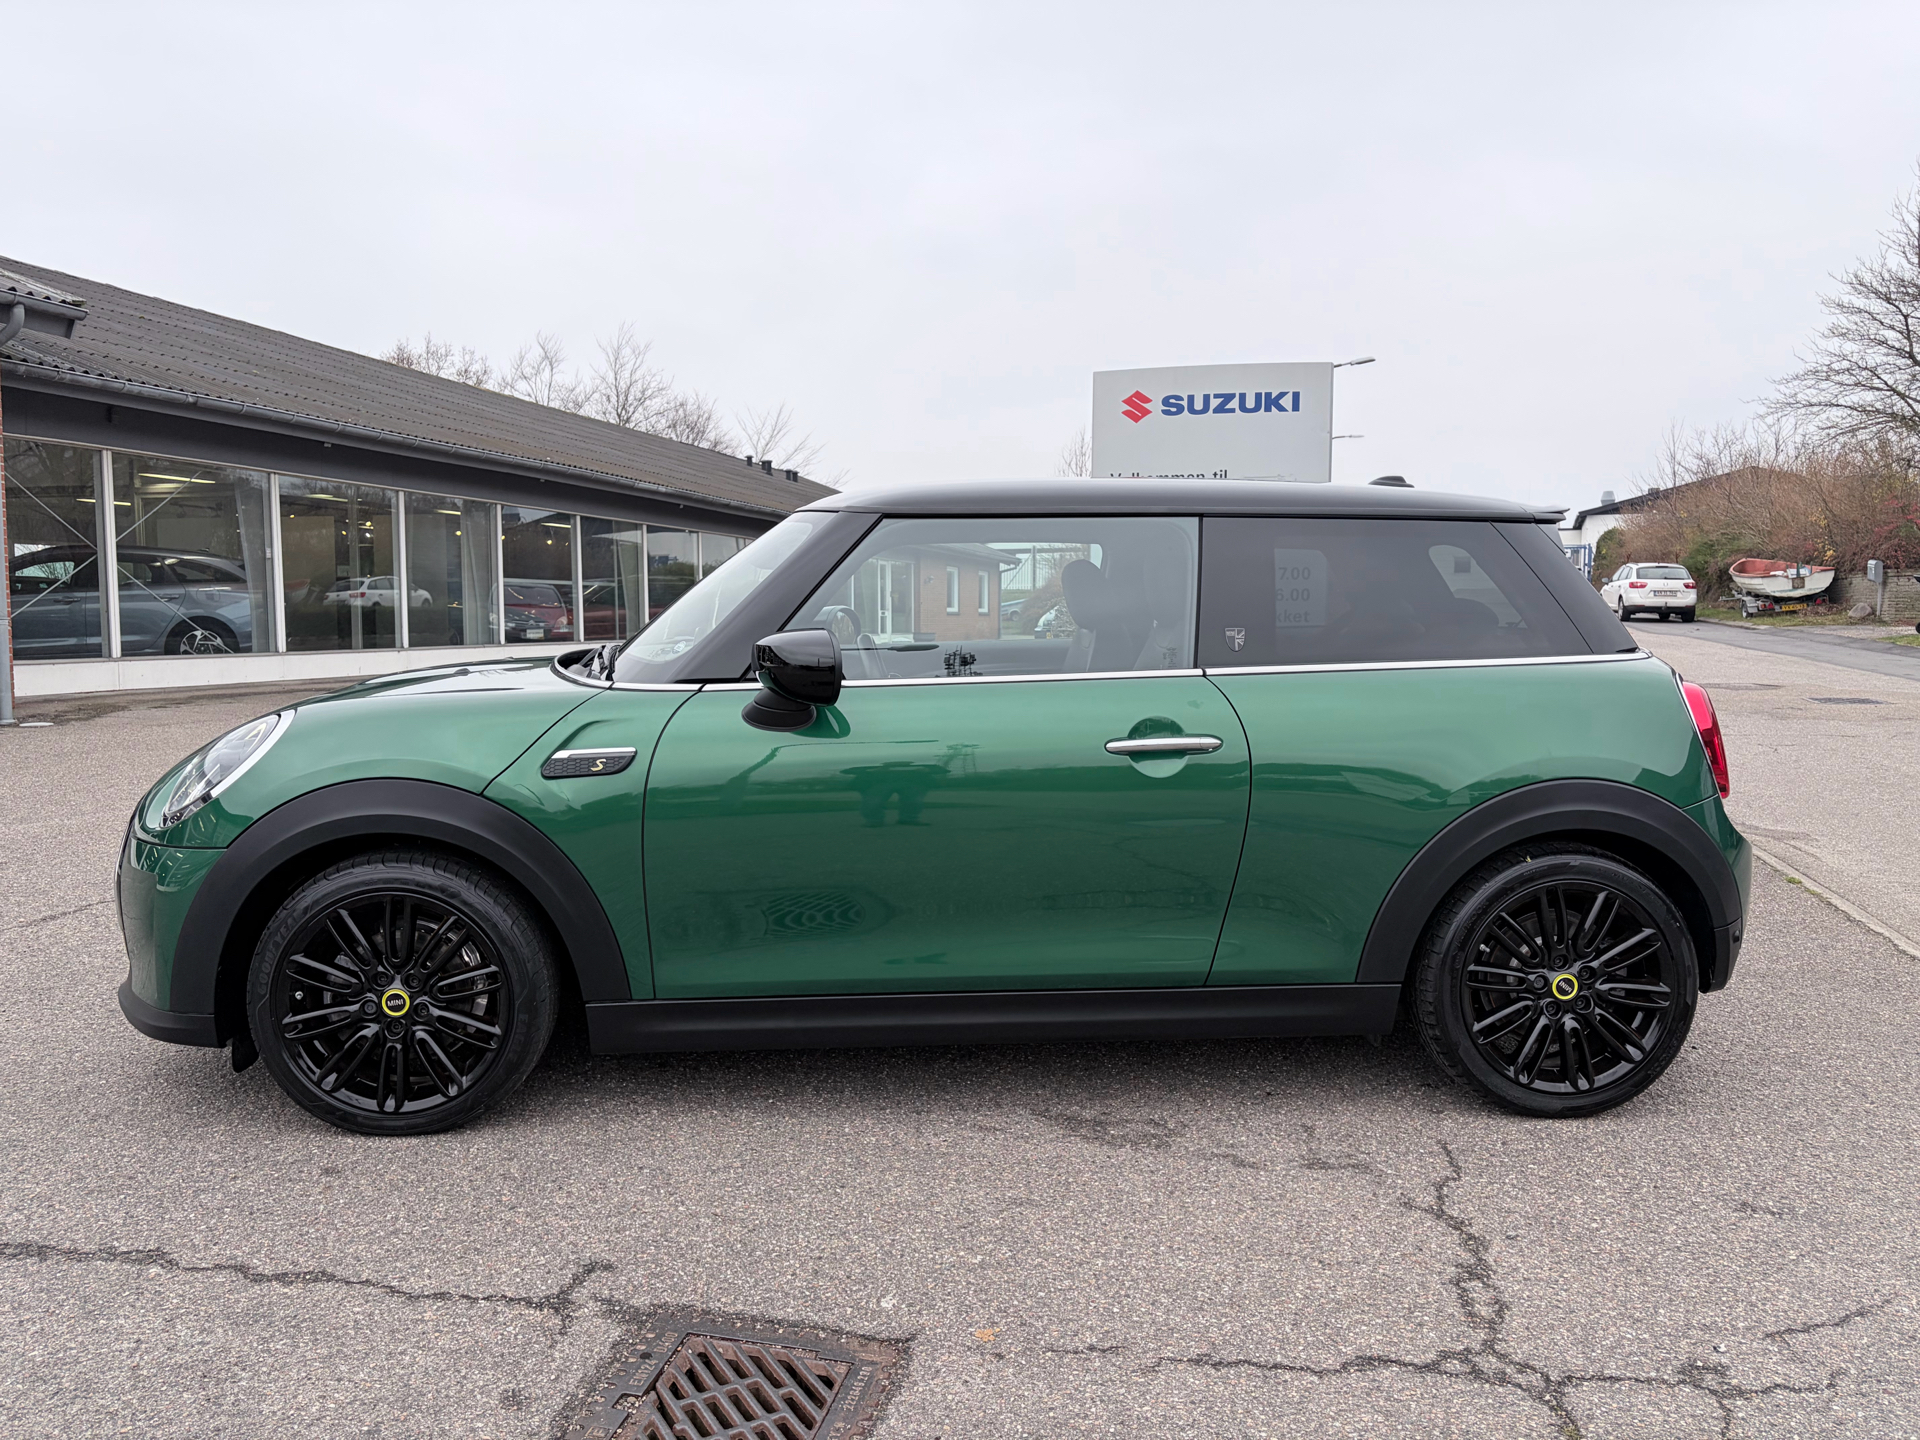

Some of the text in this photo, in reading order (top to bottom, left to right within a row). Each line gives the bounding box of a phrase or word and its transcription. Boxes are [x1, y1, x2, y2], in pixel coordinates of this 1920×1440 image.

[1161, 391, 1300, 416] SUZUKI
[1213, 469, 1228, 479] til
[1278, 567, 1311, 580] 7.00
[1275, 588, 1311, 602] 6.00
[590, 758, 607, 772] S
[1558, 980, 1573, 993] MINI
[387, 998, 404, 1007] MINI
[653, 1331, 678, 1353] D400
